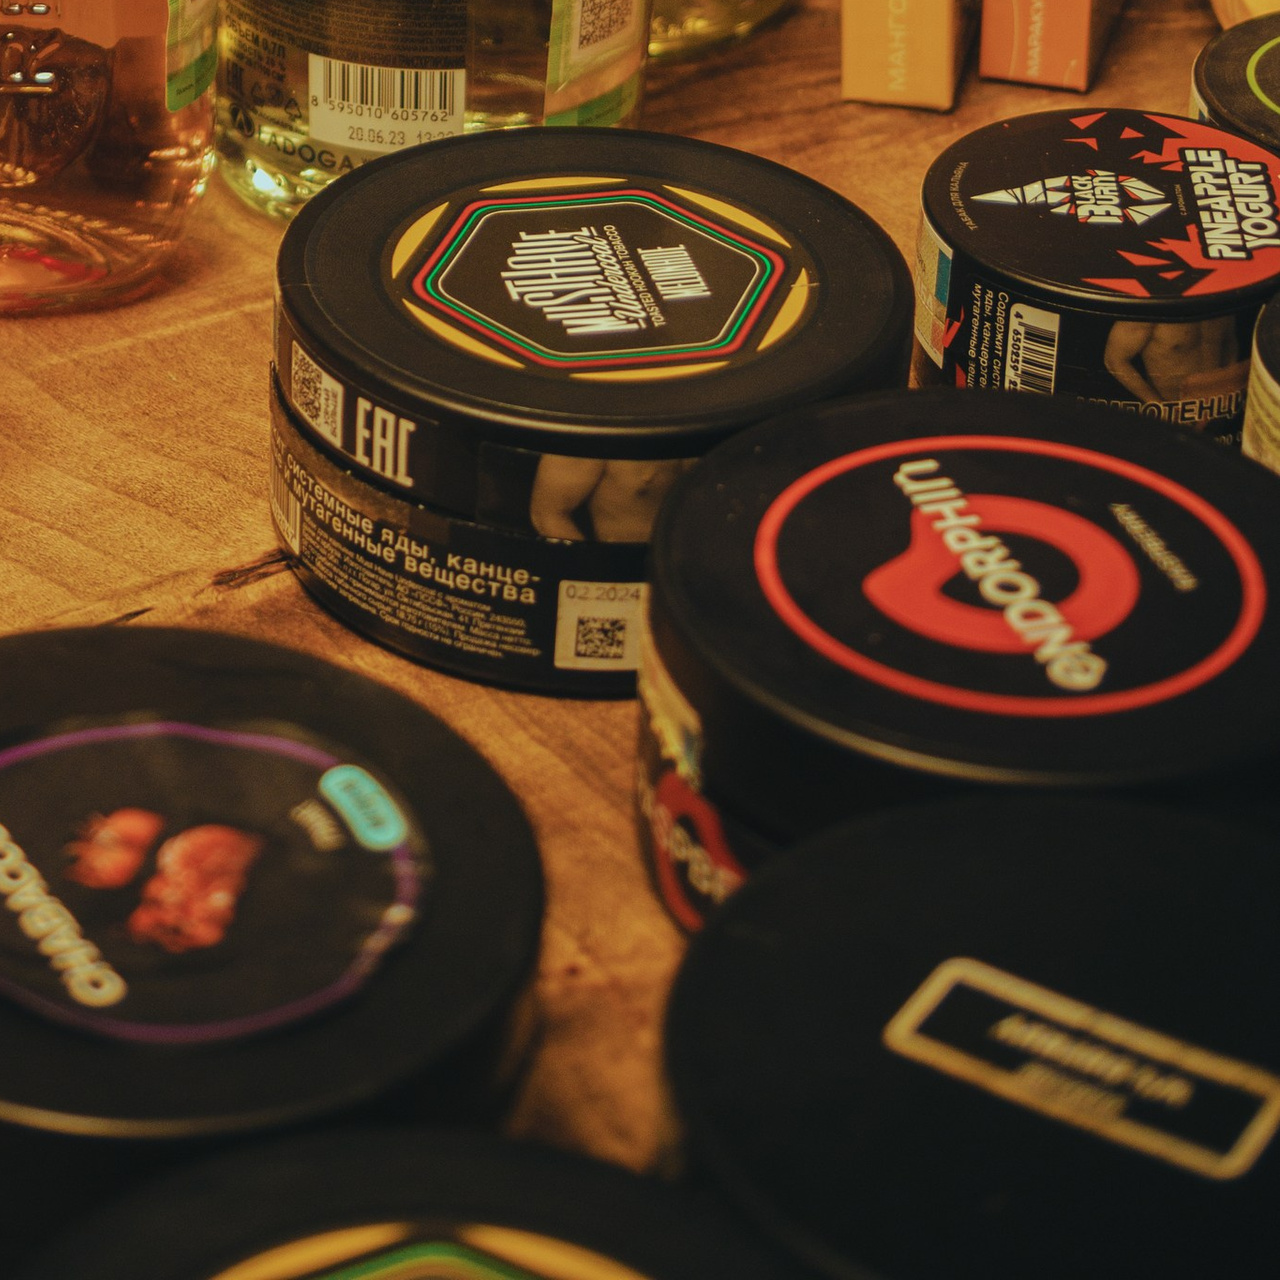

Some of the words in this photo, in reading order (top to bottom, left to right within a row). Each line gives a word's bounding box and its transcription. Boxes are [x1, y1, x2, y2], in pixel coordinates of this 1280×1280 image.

[311, 95, 319, 107] 8
[328, 101, 383, 119] 595010
[391, 109, 449, 122] 605762
[258, 124, 354, 172] LADOGA
[347, 126, 406, 146] 20.06.23
[1184, 150, 1247, 259] PINEAPPLE
[1225, 160, 1280, 249] YOGURT
[604, 225, 629, 261] TOBACCO
[621, 260, 647, 296] HOOKAH
[639, 292, 666, 328] TOASTED
[968, 283, 982, 358] мутагенные
[994, 291, 1010, 358] Содержит
[1010, 328, 1022, 372] 650259
[992, 359, 1002, 389] сист
[286, 453, 374, 534] системные
[381, 528, 436, 565] яды,
[447, 553, 541, 585] канце-
[293, 482, 396, 564] мутагенные
[404, 550, 537, 605] вещества
